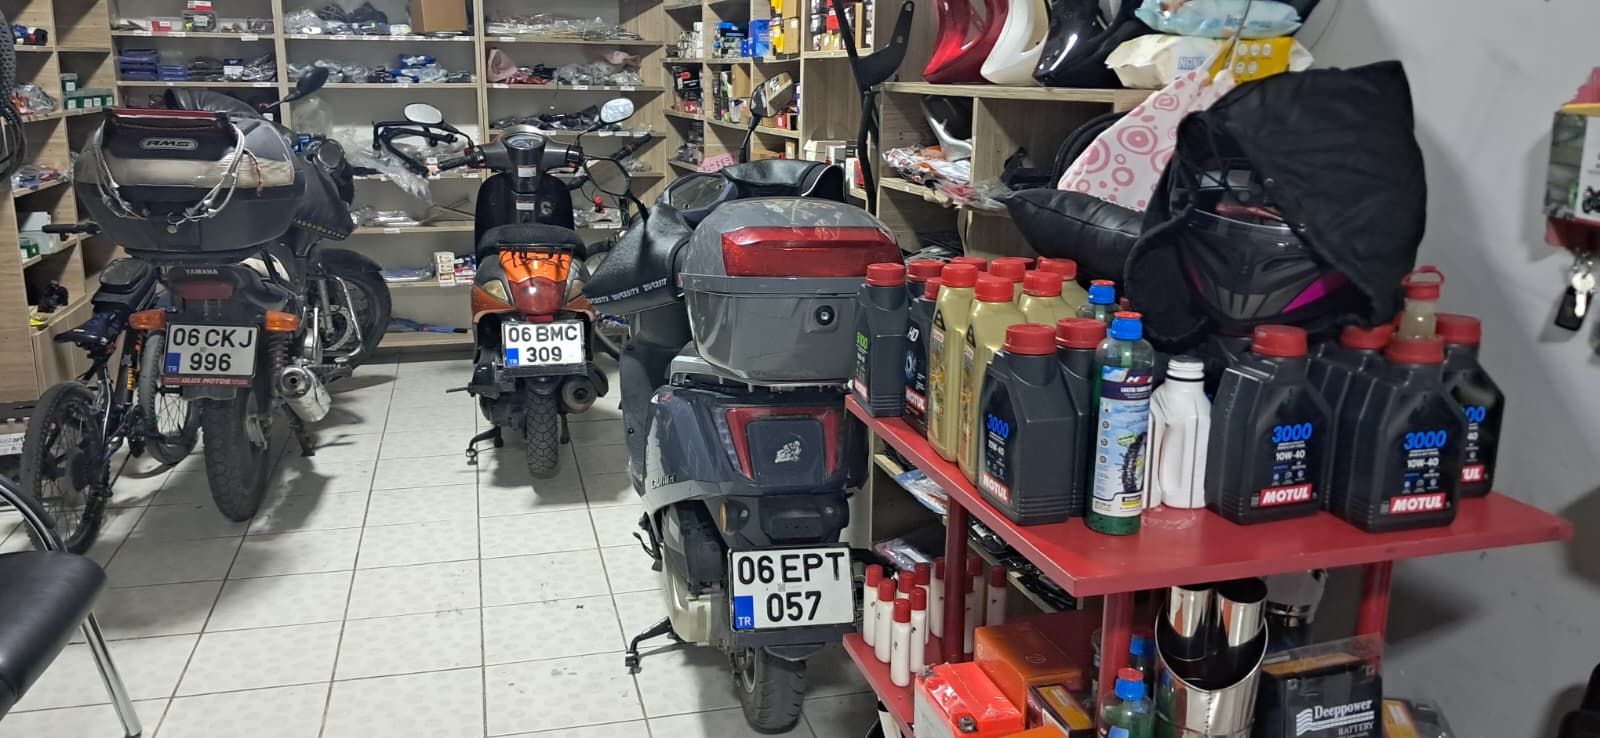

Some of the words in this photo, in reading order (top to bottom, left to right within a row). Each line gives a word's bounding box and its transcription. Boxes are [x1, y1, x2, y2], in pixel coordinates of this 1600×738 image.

[173, 327, 200, 346] 06
[205, 329, 253, 348] CKJ
[508, 327, 531, 342] 06
[536, 325, 578, 342] BMC
[907, 326, 920, 342] HD
[190, 352, 232, 372] 996
[526, 346, 562, 362] 309
[202, 377, 231, 385] MOTOR
[986, 413, 1010, 440] 3000
[1272, 422, 1313, 443] 3000
[1403, 430, 1447, 450] 3000
[1276, 449, 1306, 462] 10W-40
[1407, 457, 1440, 468] 10W-40
[982, 474, 1008, 502] MOTUL
[1262, 486, 1310, 504] MOTUL
[1391, 496, 1442, 512] MOTUL
[737, 555, 775, 585] 06
[780, 552, 845, 583] EPT
[766, 590, 822, 623] 057
[738, 616, 752, 627] TR
[1314, 699, 1373, 719] Deeppower
[1338, 721, 1375, 736] BATTERY
